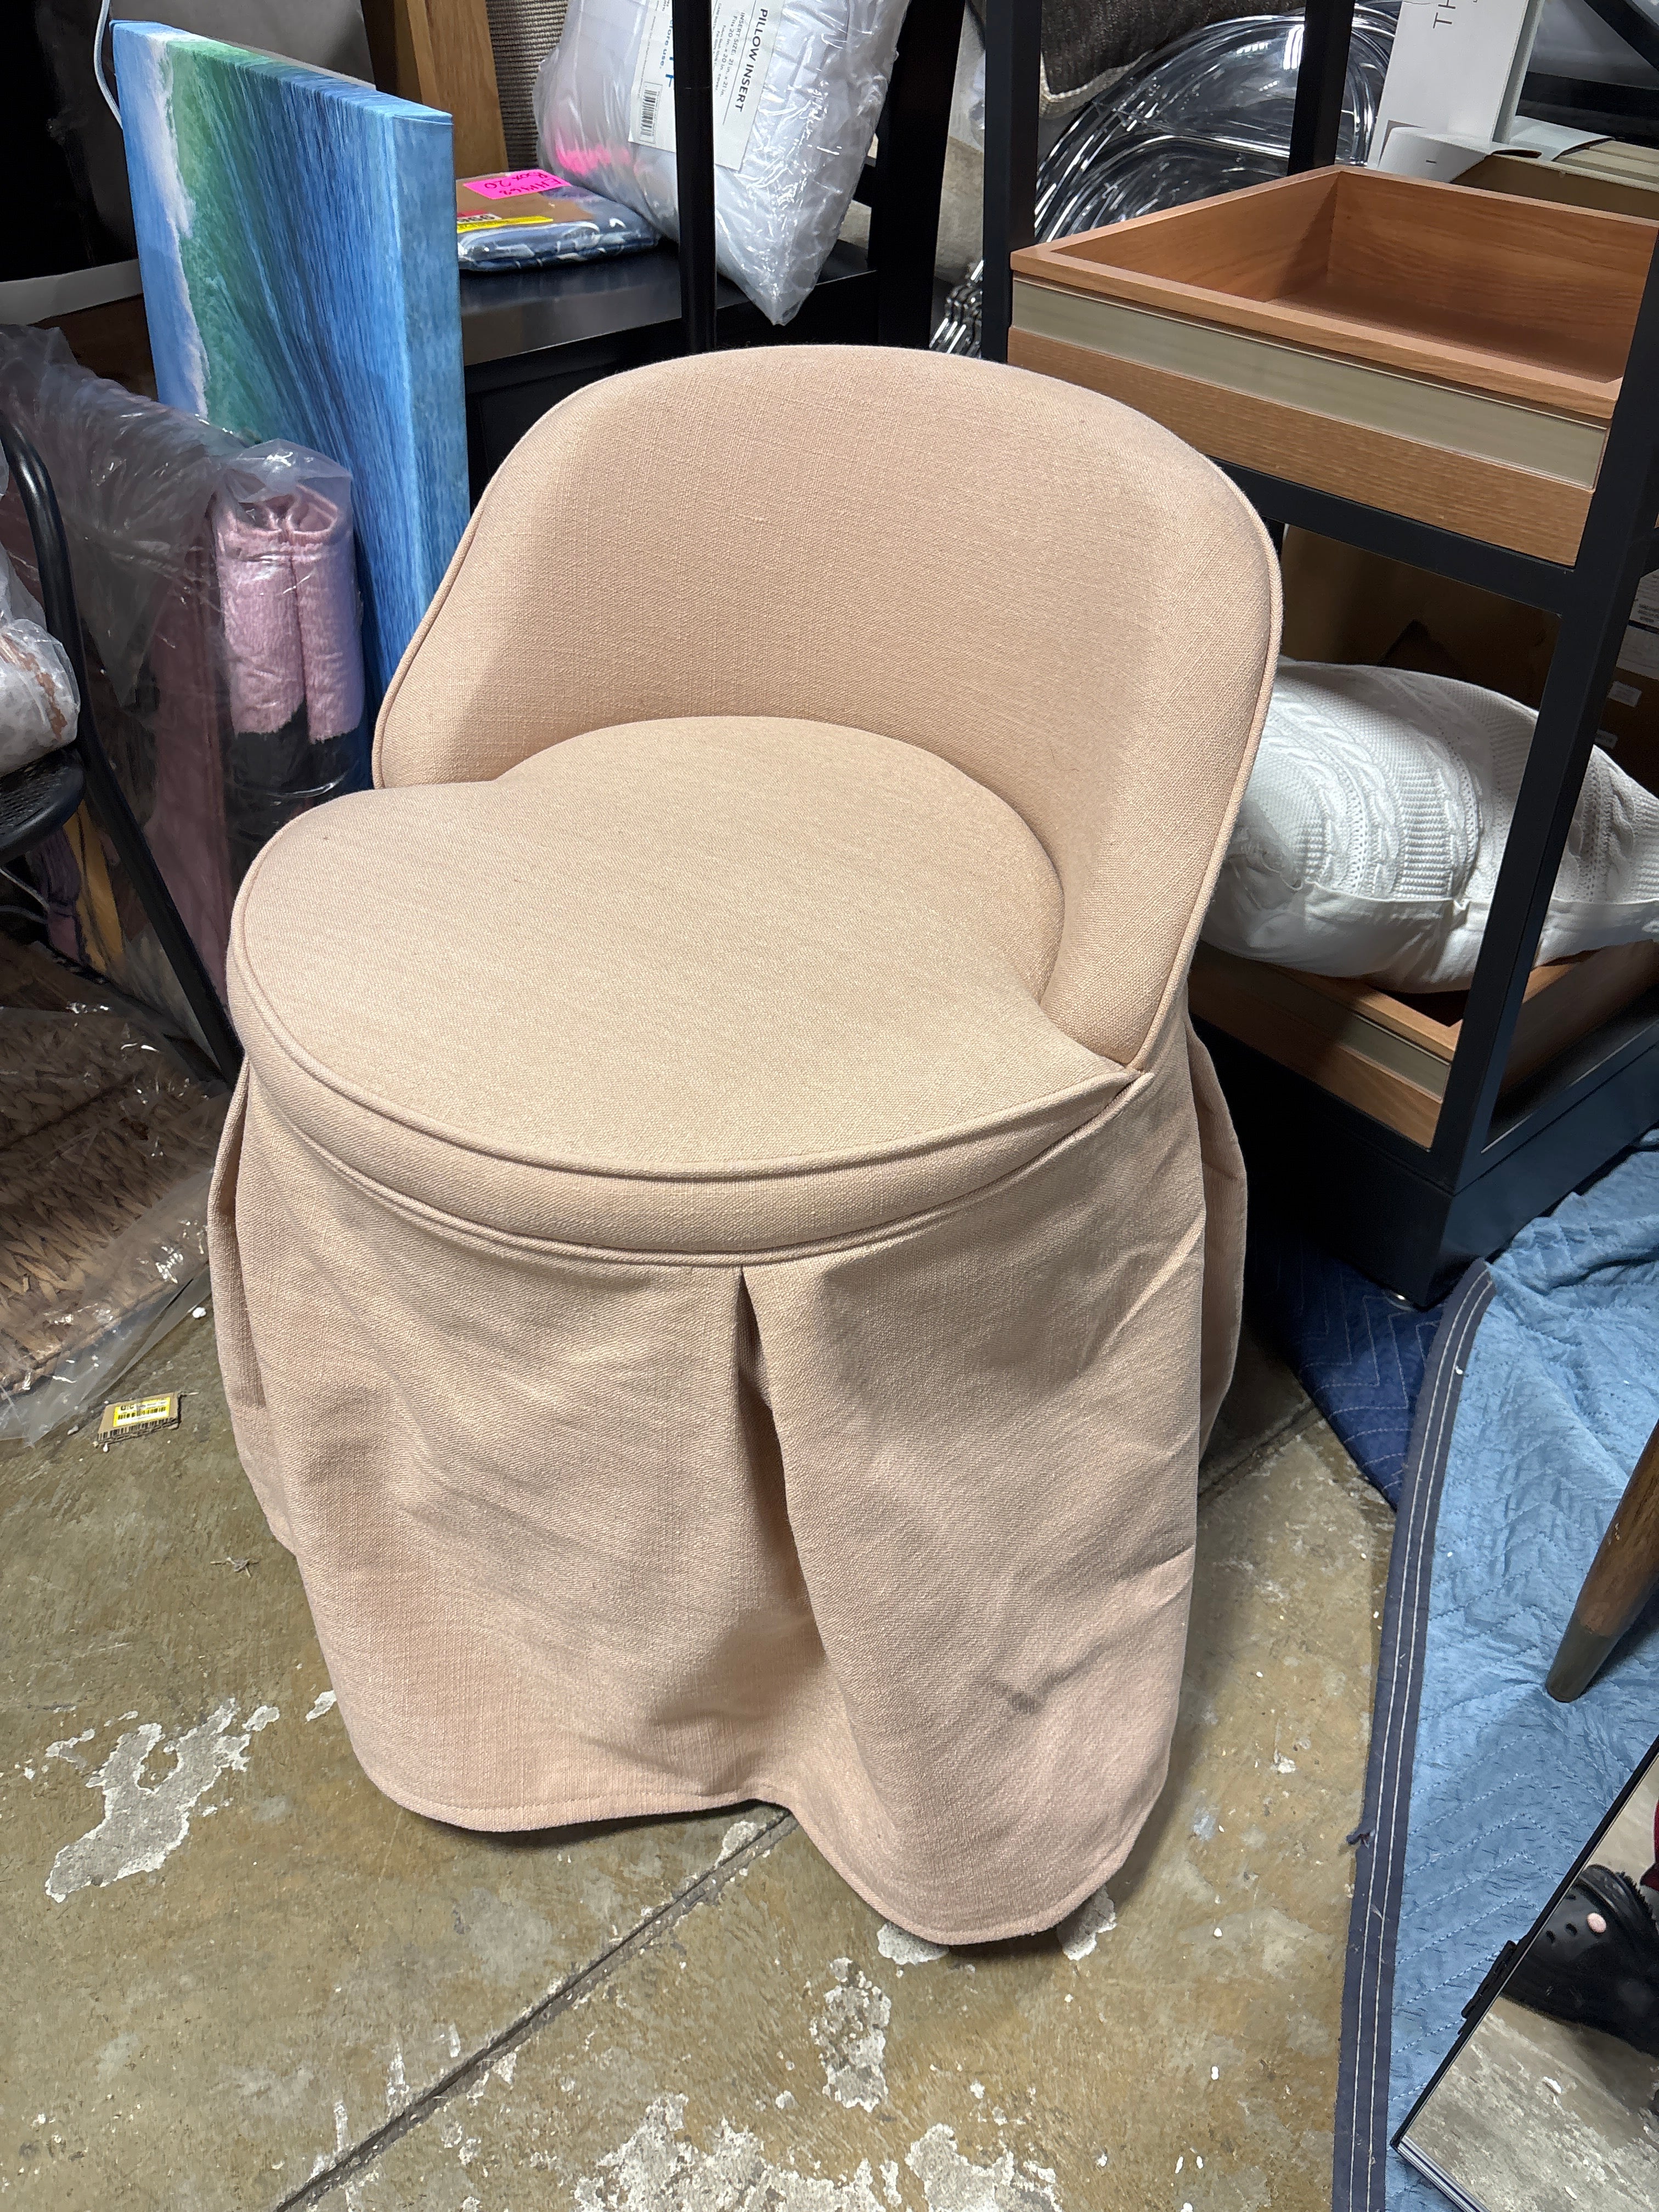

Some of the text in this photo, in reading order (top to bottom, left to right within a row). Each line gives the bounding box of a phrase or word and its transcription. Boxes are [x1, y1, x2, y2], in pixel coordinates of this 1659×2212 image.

[736, 12, 746, 37] INSERT
[728, 29, 734, 38] 20
[721, 54, 727, 63] 20
[735, 8, 768, 112] PILLOW INSERT
[484, 179, 512, 189] 20
